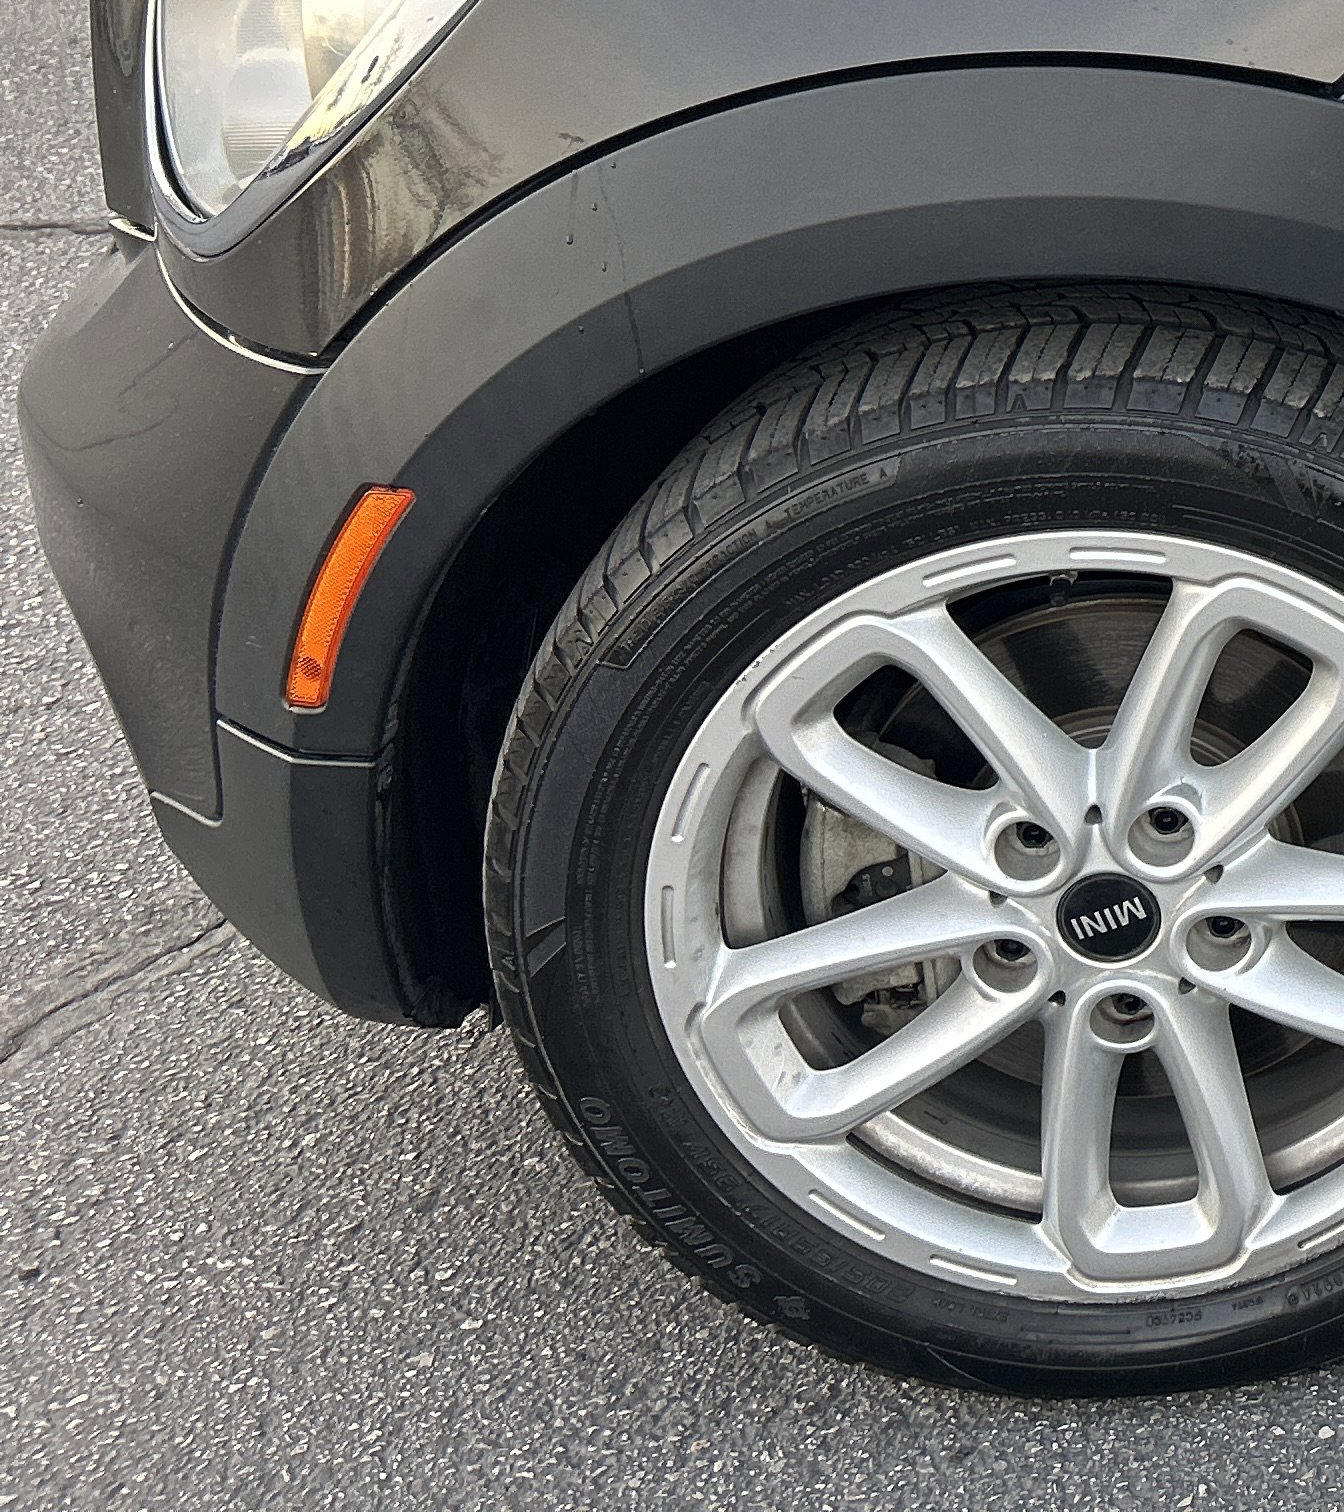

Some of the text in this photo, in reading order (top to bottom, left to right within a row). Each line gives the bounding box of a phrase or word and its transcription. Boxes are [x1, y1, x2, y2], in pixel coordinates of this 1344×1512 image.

[781, 470, 871, 520] TEMPERATURE
[875, 467, 887, 479] A
[1070, 896, 1147, 940] MINI
[572, 1088, 769, 1296] SUMITOMO
